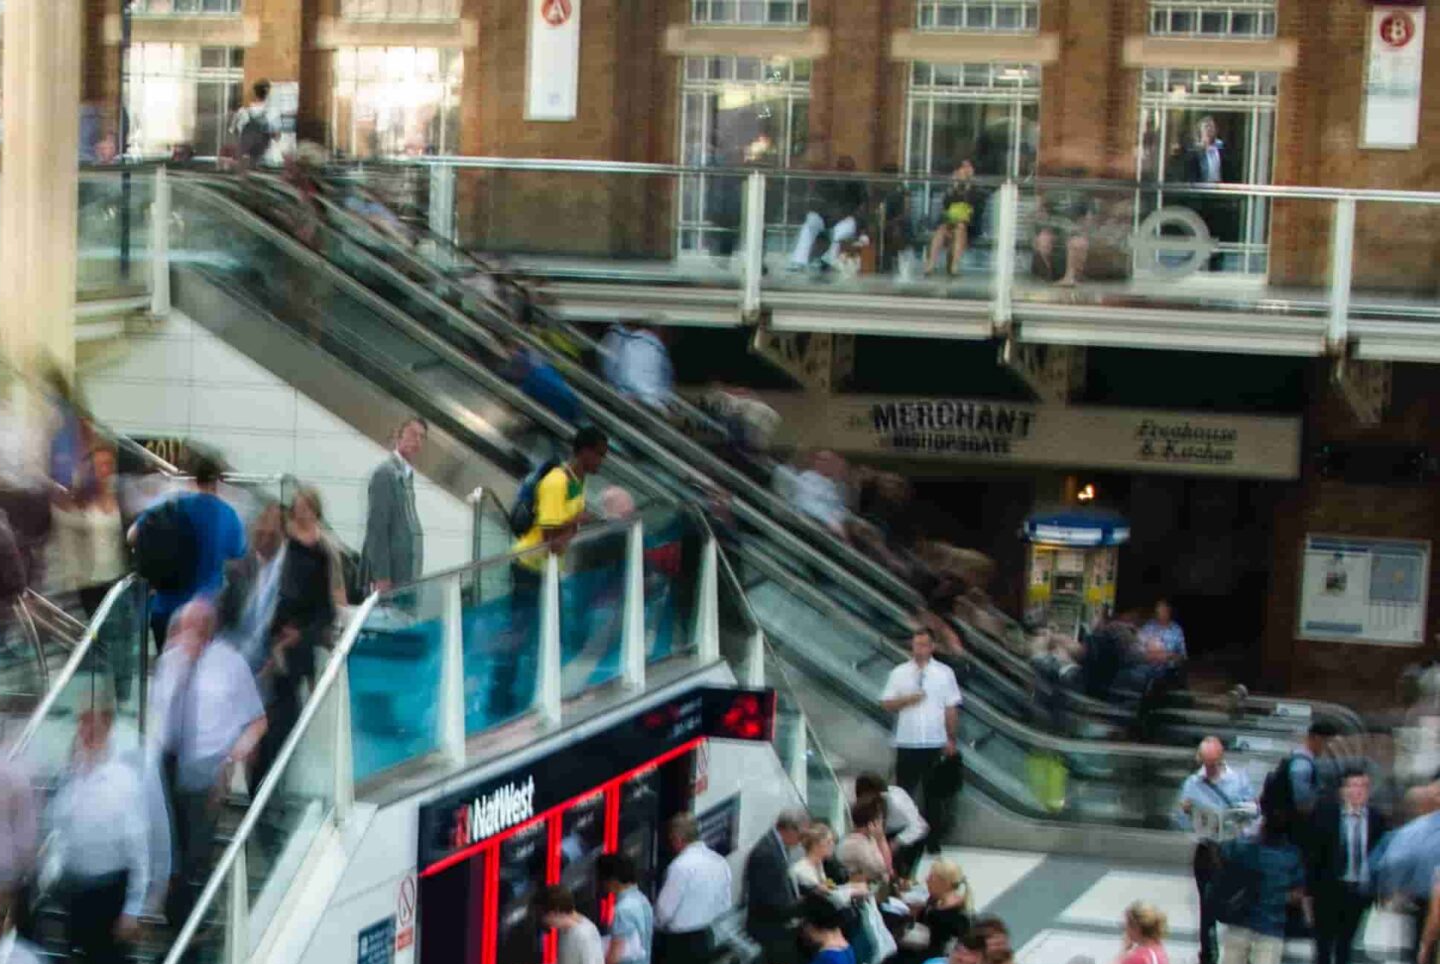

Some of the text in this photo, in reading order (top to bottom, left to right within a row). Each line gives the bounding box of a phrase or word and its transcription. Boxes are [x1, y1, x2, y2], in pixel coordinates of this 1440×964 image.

[872, 401, 1035, 437] MERCHANT
[893, 433, 1010, 453] BISHOPSGATE
[472, 774, 535, 843] NatWest
